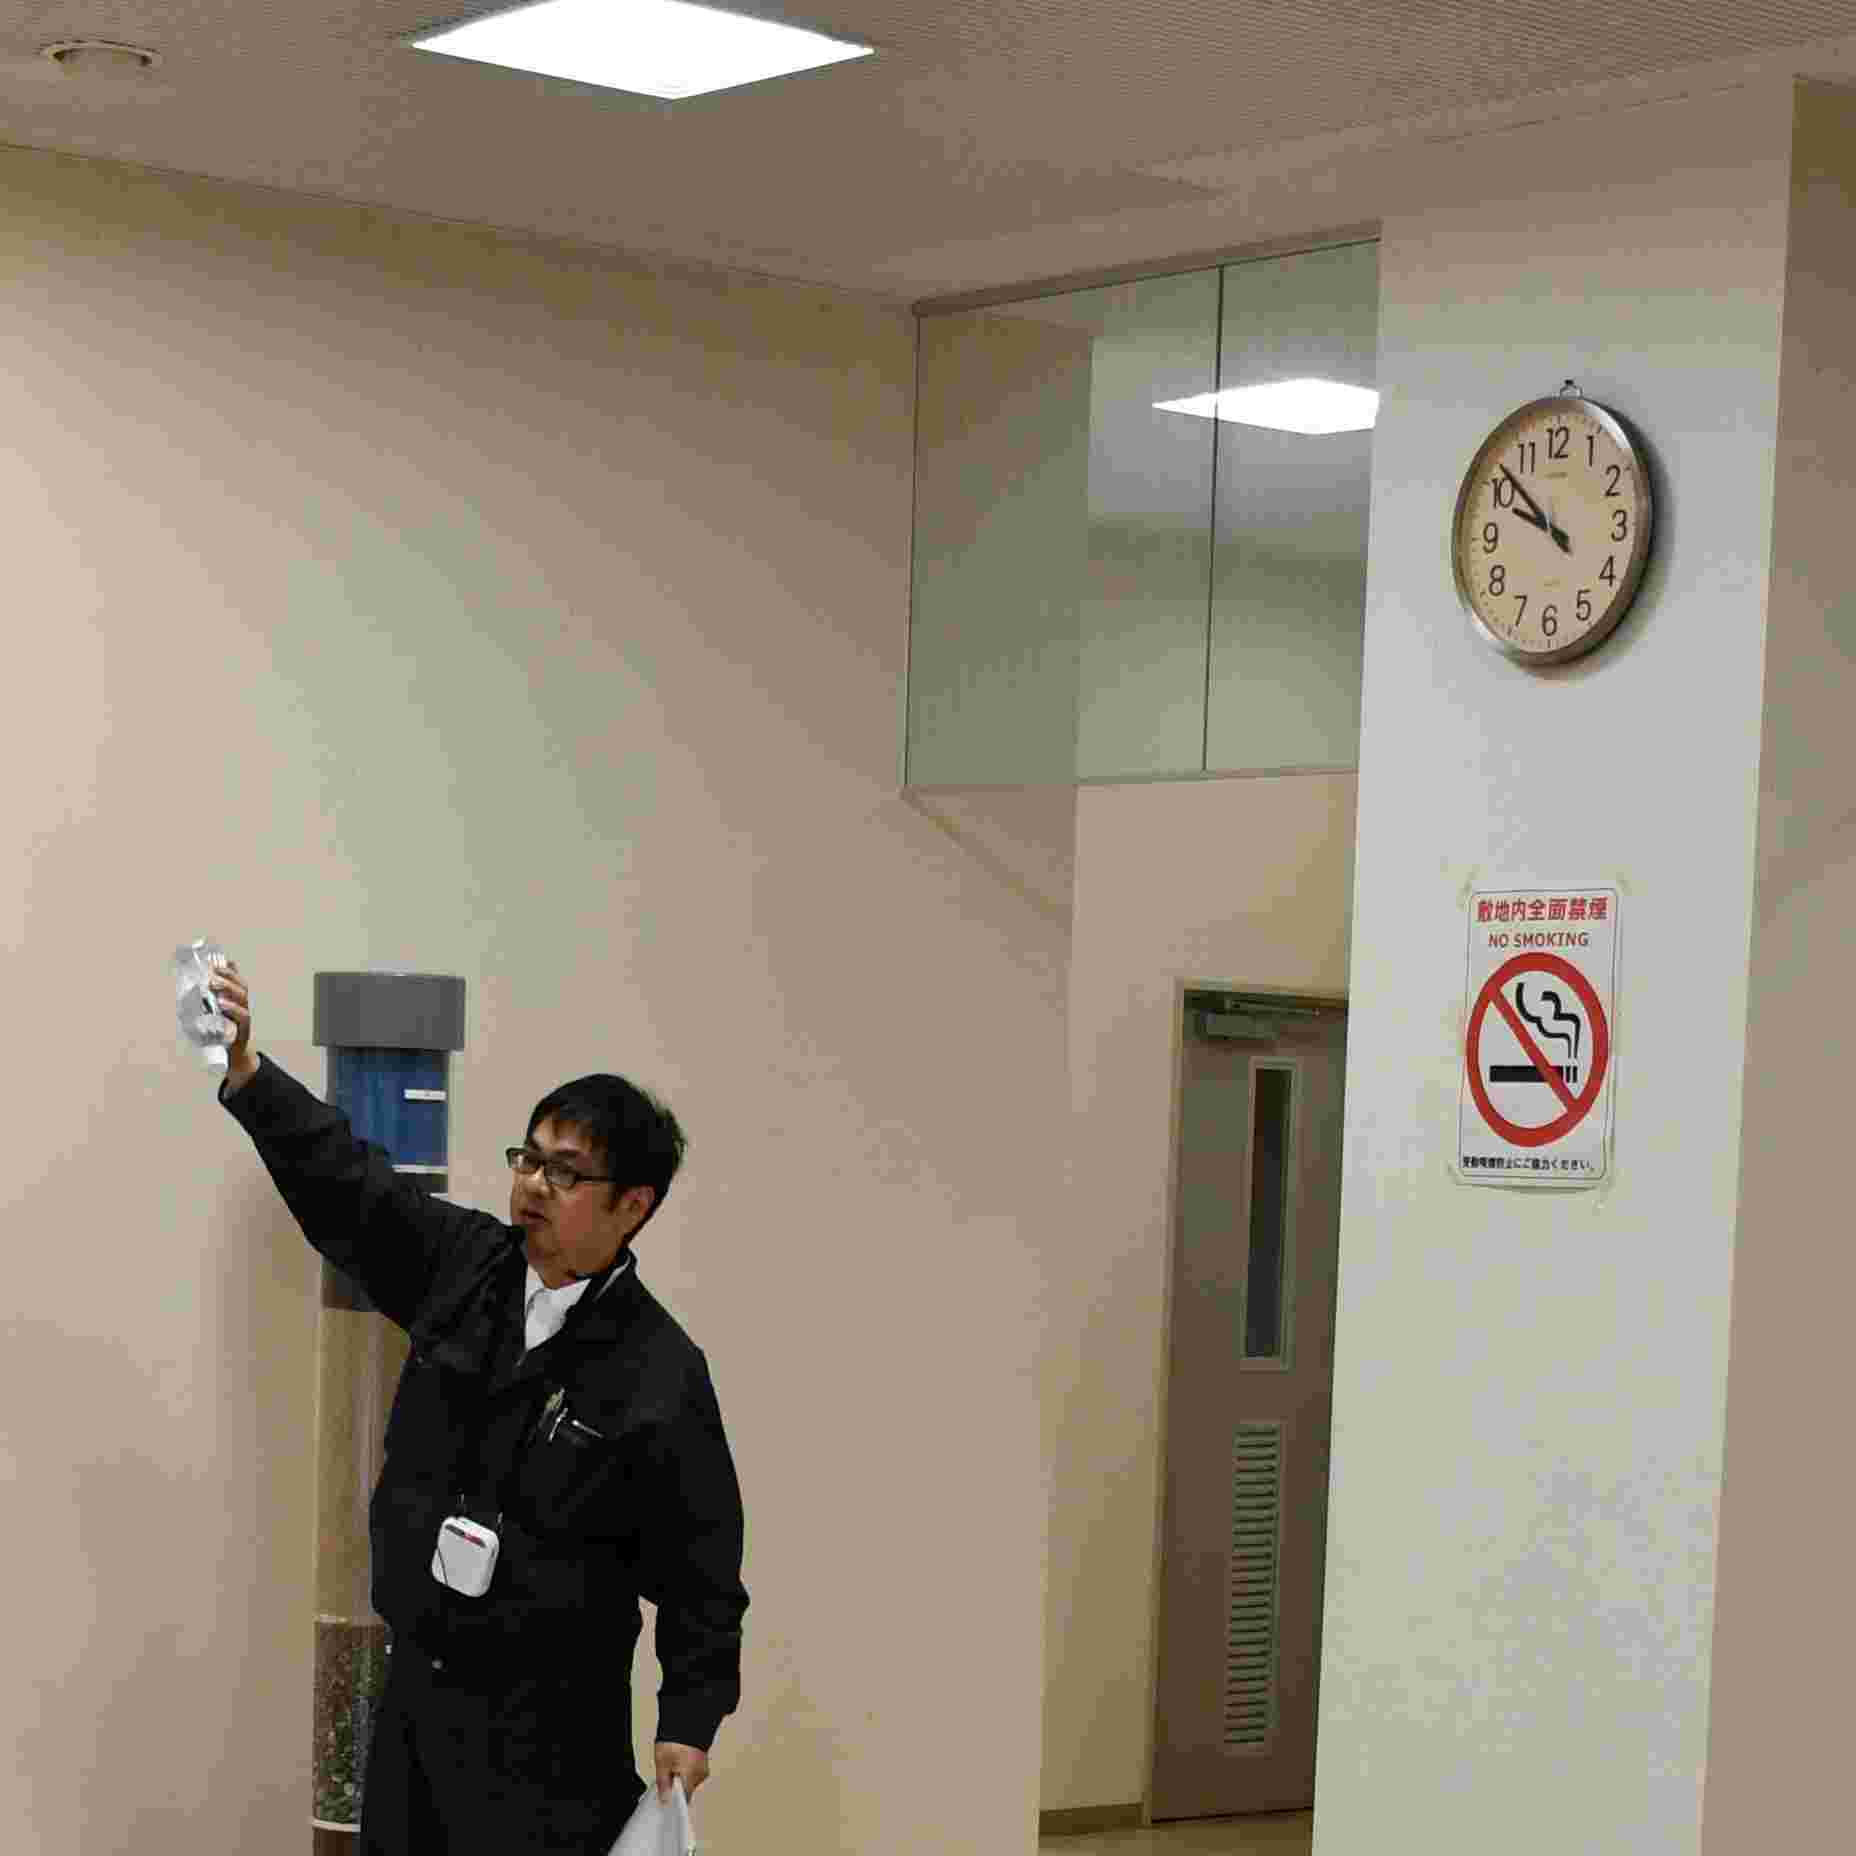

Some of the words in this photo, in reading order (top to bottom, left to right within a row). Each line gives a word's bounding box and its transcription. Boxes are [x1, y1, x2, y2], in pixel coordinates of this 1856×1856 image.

[1517, 441, 1536, 474] 11
[1546, 426, 1570, 460] 12
[1587, 434, 1595, 467] 1
[1492, 478, 1514, 509] 10
[1605, 464, 1622, 497] 2
[1482, 522, 1499, 554] 9
[1610, 509, 1628, 542] 3
[1488, 564, 1506, 597] 8
[1598, 555, 1617, 587] 4
[1513, 595, 1528, 627] 7
[1541, 604, 1559, 637] 6
[1575, 589, 1592, 622] 5
[1476, 896, 1608, 923] 敷地内全面禁煙
[1488, 933, 1510, 949] NO
[1513, 931, 1590, 949] SMOKING
